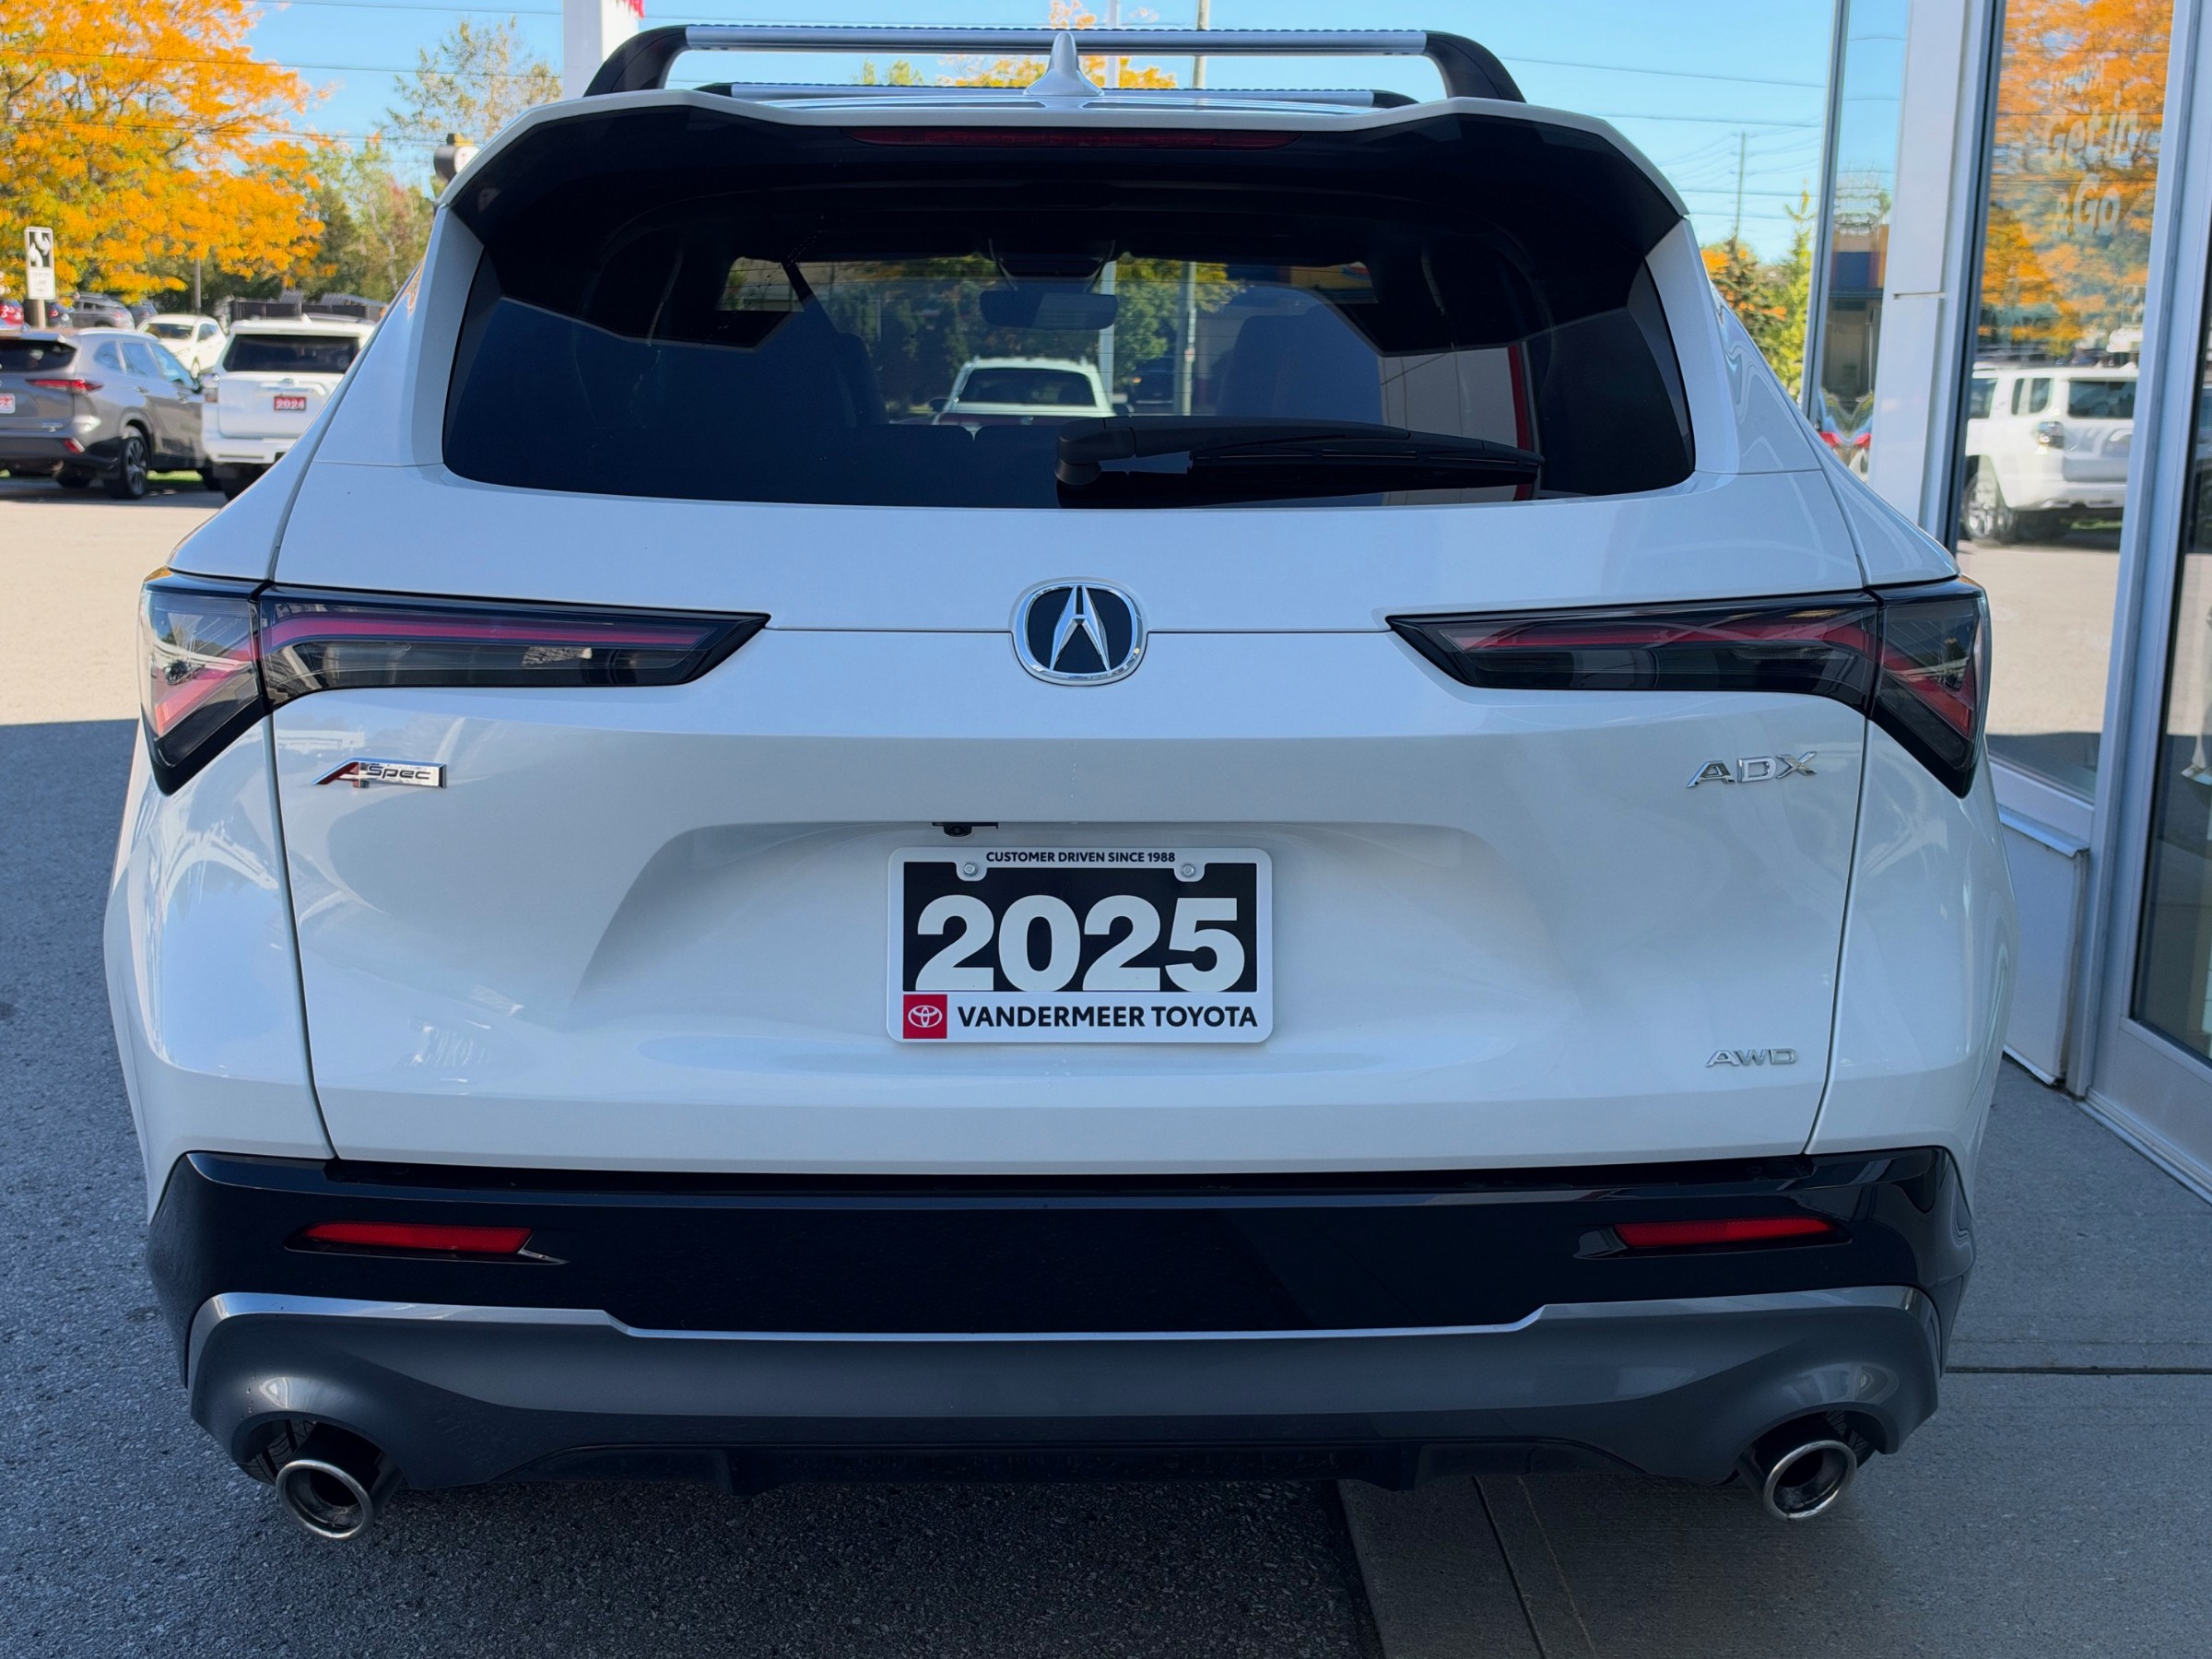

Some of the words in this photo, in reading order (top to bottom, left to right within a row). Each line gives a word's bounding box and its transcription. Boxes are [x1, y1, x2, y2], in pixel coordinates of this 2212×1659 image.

[2073, 172, 2121, 236] Go
[1686, 750, 1818, 789] ADX
[985, 852, 1055, 863] CUSTOMER
[1058, 852, 1105, 863] DRIVEN
[1108, 852, 1145, 863] SINCE
[1147, 852, 1176, 863] 1988
[915, 895, 1245, 993] 2025
[957, 1006, 1146, 1028] VANDERMEER
[1153, 1006, 1258, 1028] TOYOTA
[1704, 1048, 1798, 1068] AWD
